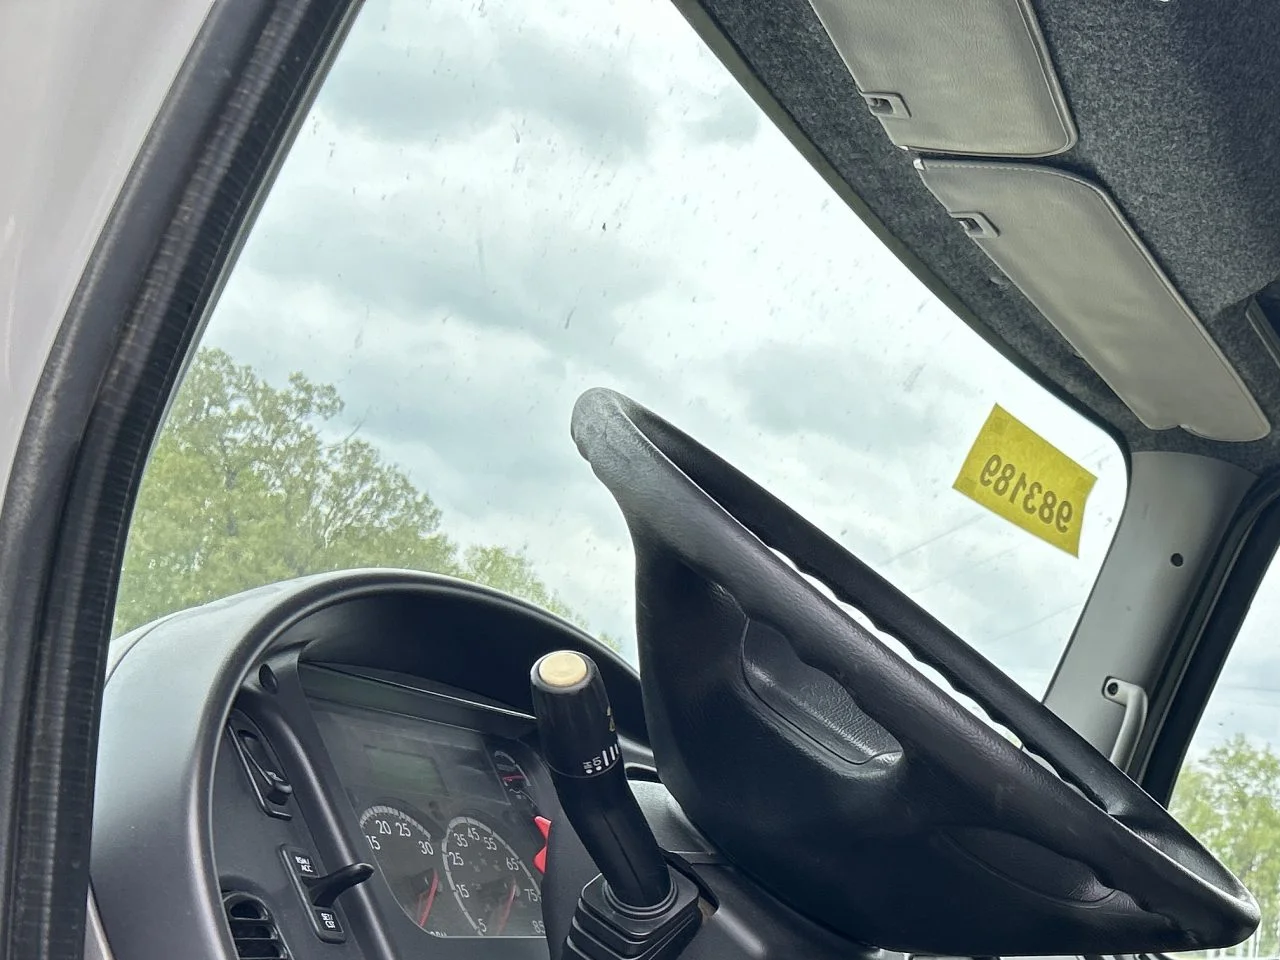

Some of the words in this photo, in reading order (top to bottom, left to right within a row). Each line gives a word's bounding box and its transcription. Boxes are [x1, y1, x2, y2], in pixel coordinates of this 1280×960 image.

[376, 820, 391, 834] 20
[395, 822, 411, 837] 25
[467, 827, 480, 841] 45
[366, 835, 381, 850] 15
[418, 840, 433, 855] 30
[453, 833, 468, 848] 35
[483, 836, 497, 851] 55
[449, 852, 464, 866] 25
[506, 857, 519, 871] 65
[456, 884, 470, 898] 15
[524, 888, 538, 902] 75
[478, 918, 487, 932] 5
